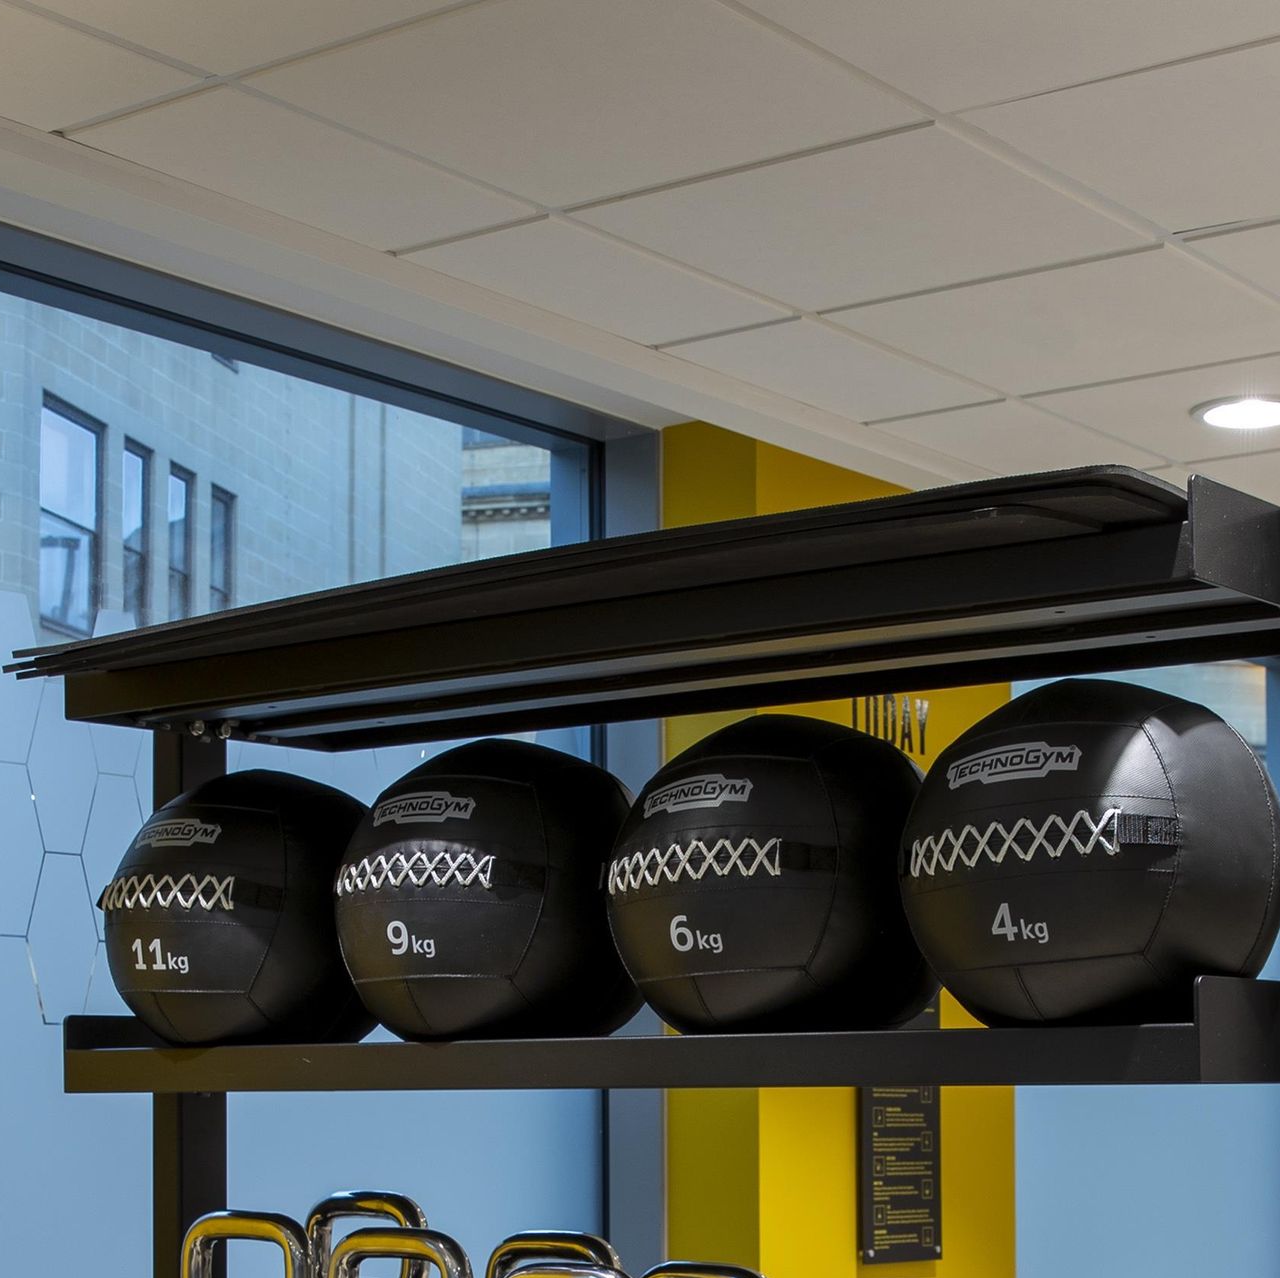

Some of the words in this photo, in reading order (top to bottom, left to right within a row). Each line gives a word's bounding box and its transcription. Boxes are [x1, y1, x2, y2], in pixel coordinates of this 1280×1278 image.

[951, 746, 1076, 782] TECHNOGYM
[377, 795, 471, 822] TECHNOGYM
[646, 780, 747, 812] TECHNOGYM
[386, 920, 436, 958] 9kg
[669, 914, 724, 953] 6kg
[992, 903, 1049, 944] 4kg
[131, 938, 190, 974] 11kg
